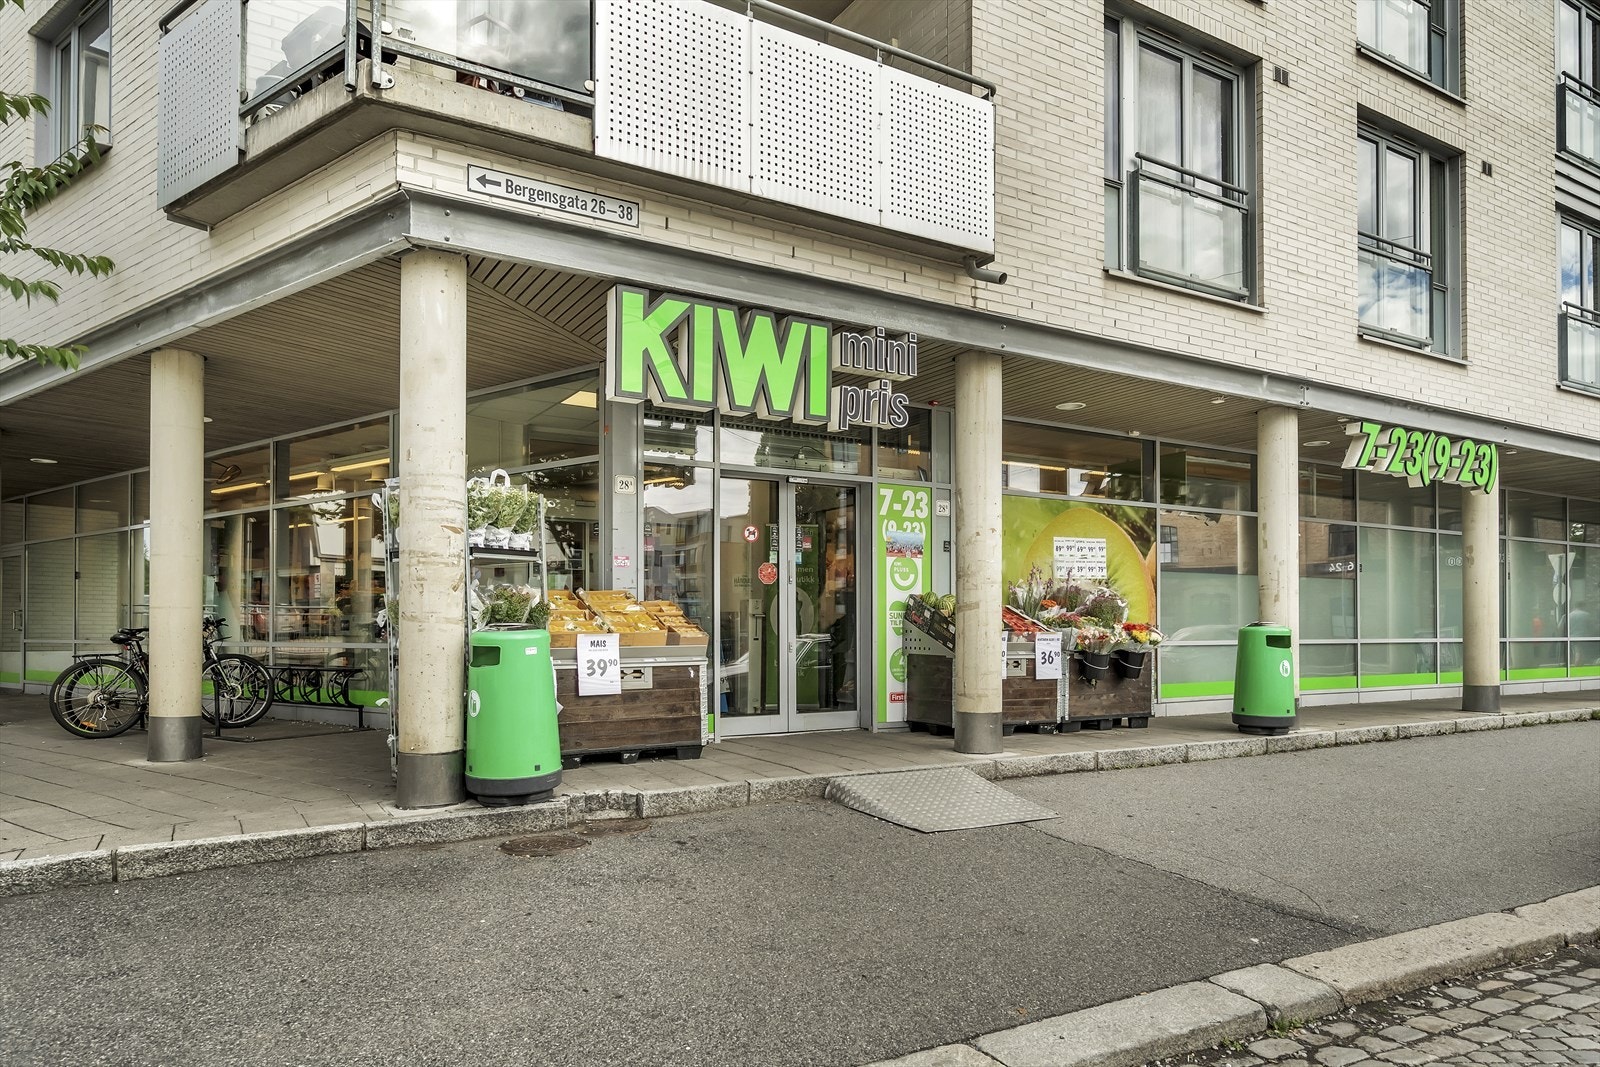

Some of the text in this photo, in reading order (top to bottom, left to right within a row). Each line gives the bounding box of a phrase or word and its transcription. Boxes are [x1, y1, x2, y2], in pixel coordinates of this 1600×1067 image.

[505, 178, 588, 211] Bergensgata
[617, 286, 831, 420] KIWI
[841, 326, 918, 377] mini
[841, 379, 910, 431] pris
[879, 488, 929, 519] 7-23
[590, 639, 607, 648] MAIS
